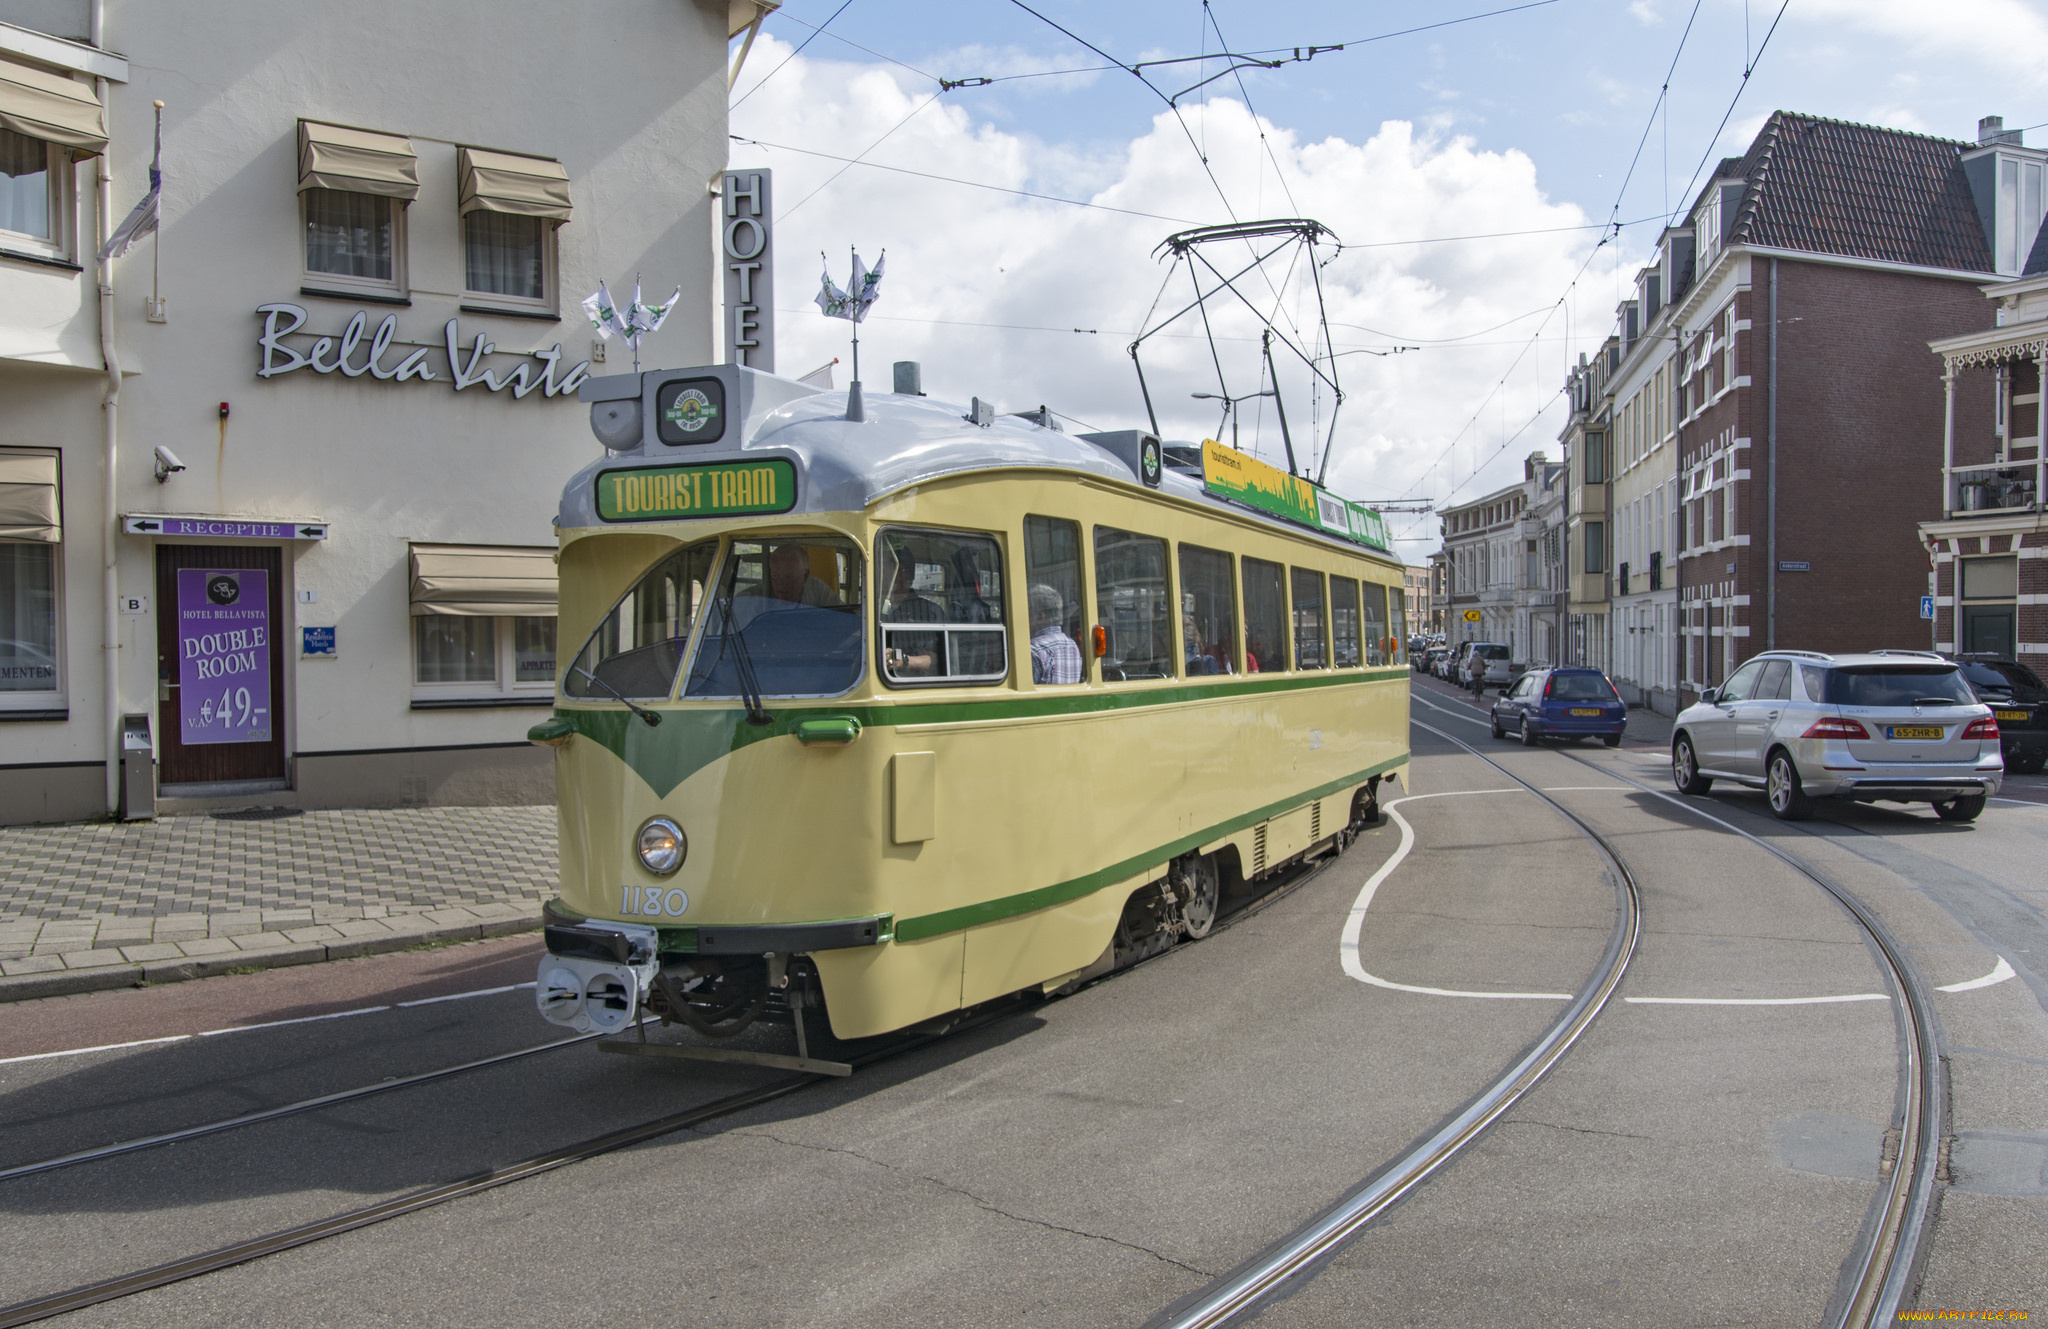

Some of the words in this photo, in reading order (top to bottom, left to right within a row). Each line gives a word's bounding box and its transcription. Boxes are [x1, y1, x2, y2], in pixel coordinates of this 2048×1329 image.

[255, 302, 438, 382] Bella
[446, 318, 592, 399] Vista
[613, 471, 703, 513] TOURIST
[708, 467, 776, 508] TRAM
[180, 521, 281, 536] RECEPTIE
[129, 600, 139, 609] B
[306, 591, 310, 601] 1
[183, 610, 212, 619] HOTEL
[215, 610, 240, 619] BELLA
[241, 610, 265, 619] VISTA
[184, 627, 266, 659] DOUBLE
[196, 651, 257, 680] ROOM
[1896, 727, 1940, 737] 65-ZHR-8
[619, 885, 689, 917] 1180
